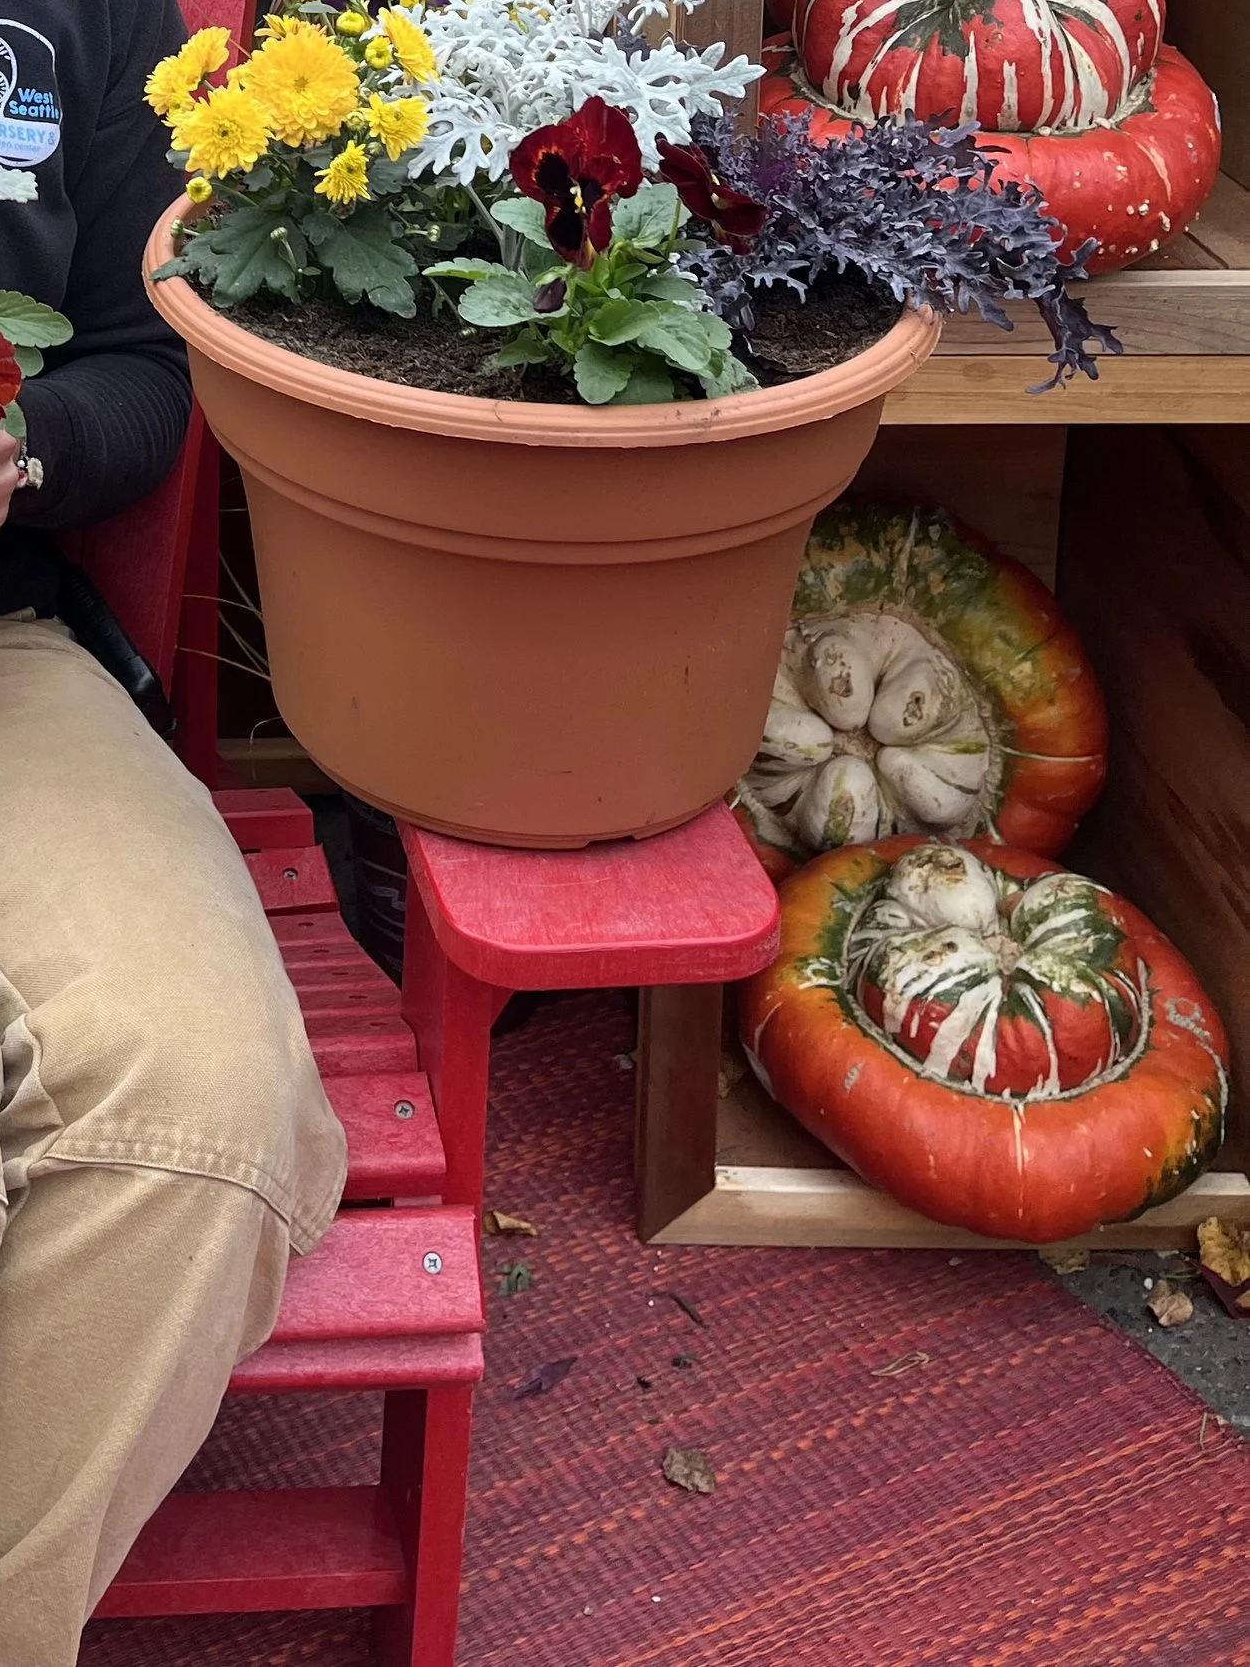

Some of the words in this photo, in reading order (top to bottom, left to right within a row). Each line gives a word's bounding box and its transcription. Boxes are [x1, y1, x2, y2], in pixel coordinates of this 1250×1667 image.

[17, 87, 53, 105] West
[47, 131, 56, 145] &
[14, 142, 41, 153] center
